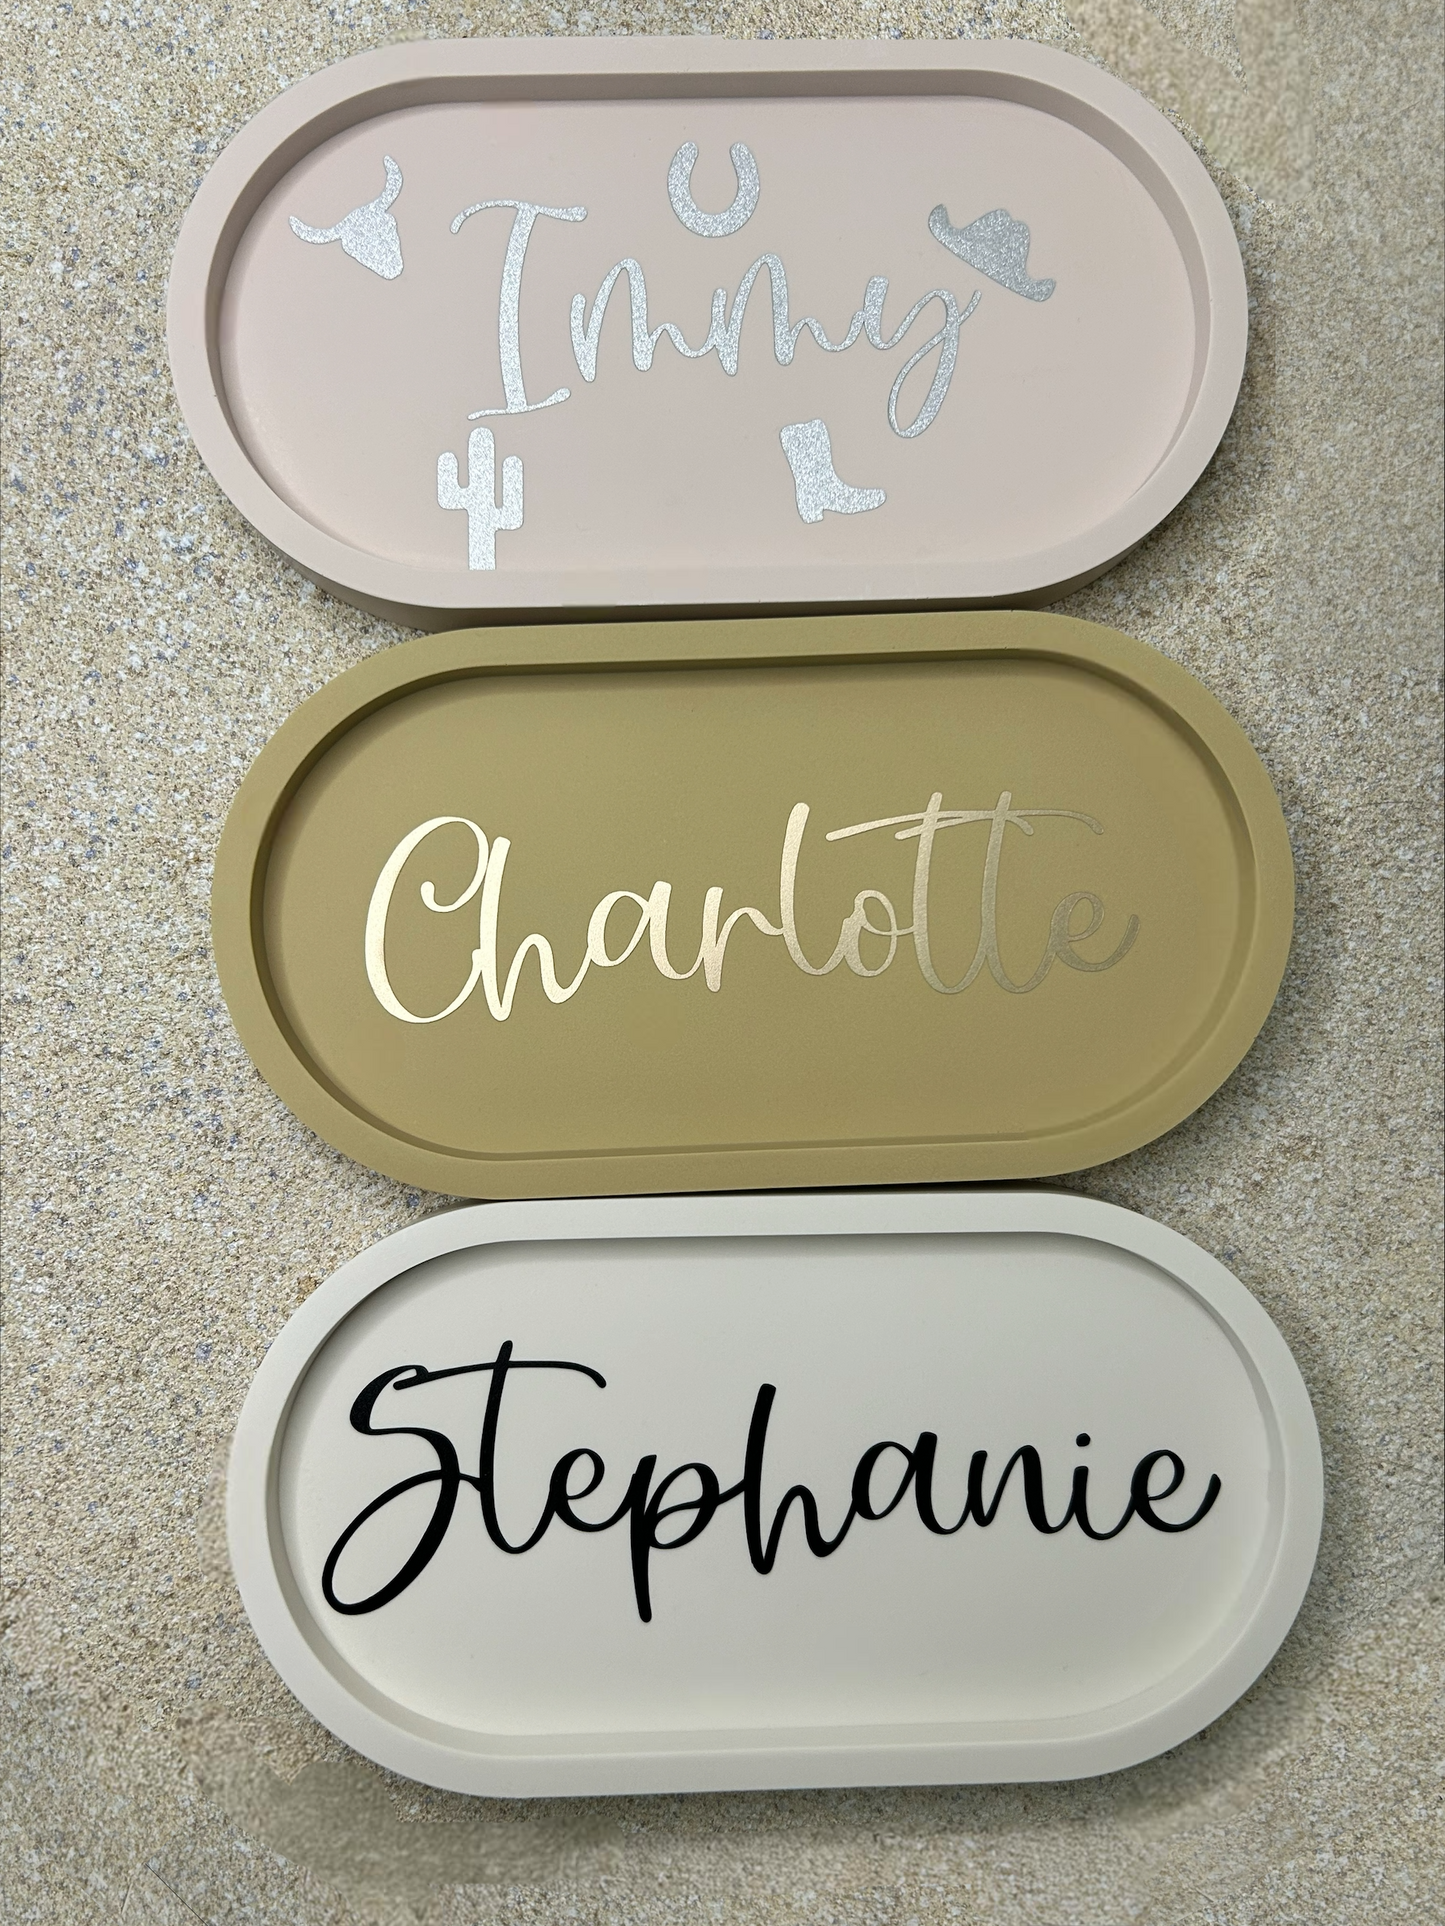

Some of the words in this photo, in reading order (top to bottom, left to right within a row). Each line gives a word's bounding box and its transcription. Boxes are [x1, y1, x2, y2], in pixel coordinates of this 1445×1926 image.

[451, 200, 982, 439] Immy
[364, 791, 1140, 1024] Charlotte
[321, 1340, 1221, 1624] Stephanie
